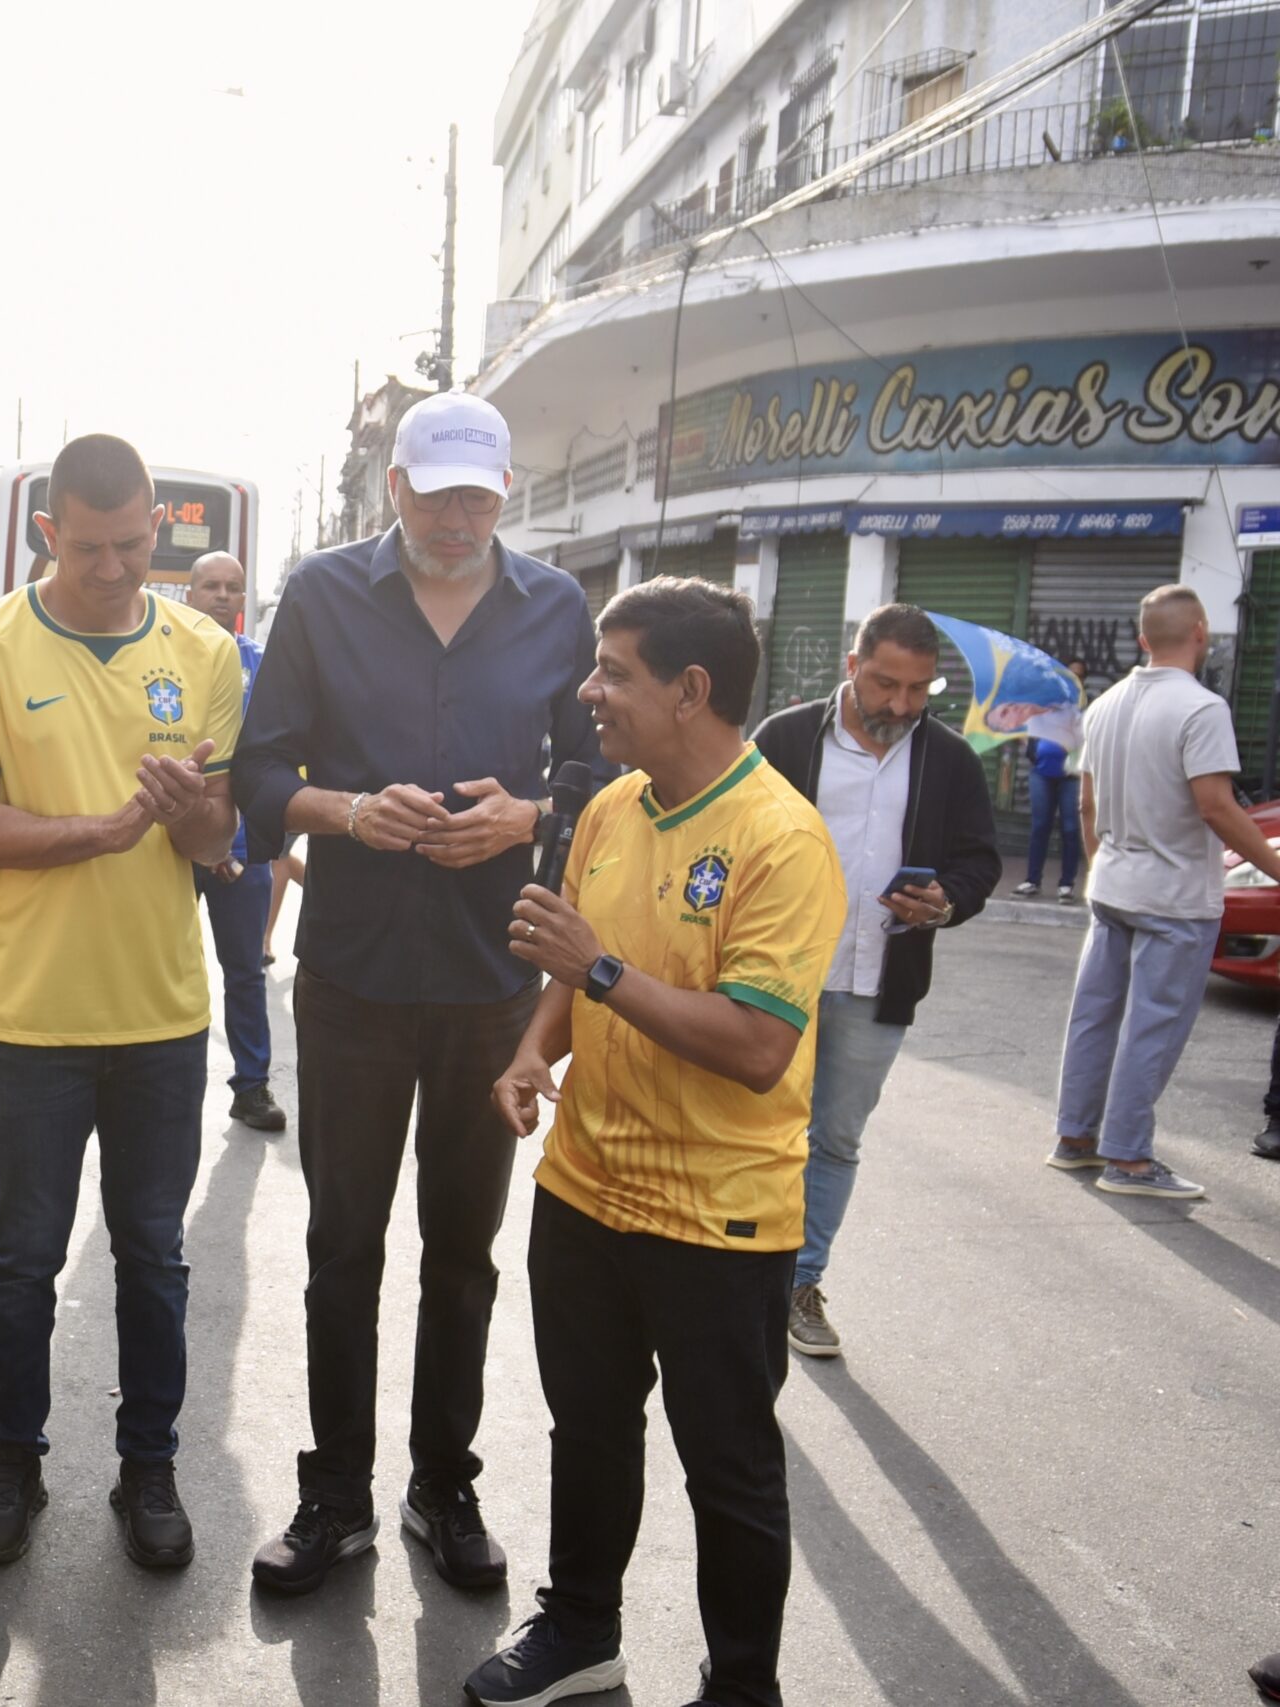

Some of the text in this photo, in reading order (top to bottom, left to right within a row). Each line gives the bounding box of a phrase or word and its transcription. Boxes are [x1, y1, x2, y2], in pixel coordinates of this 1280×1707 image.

[708, 378, 860, 468] Morelli
[868, 362, 1128, 453] Caxias
[858, 515, 908, 530] MORELLI
[913, 514, 941, 529] SOM
[148, 732, 188, 744] BRASIL
